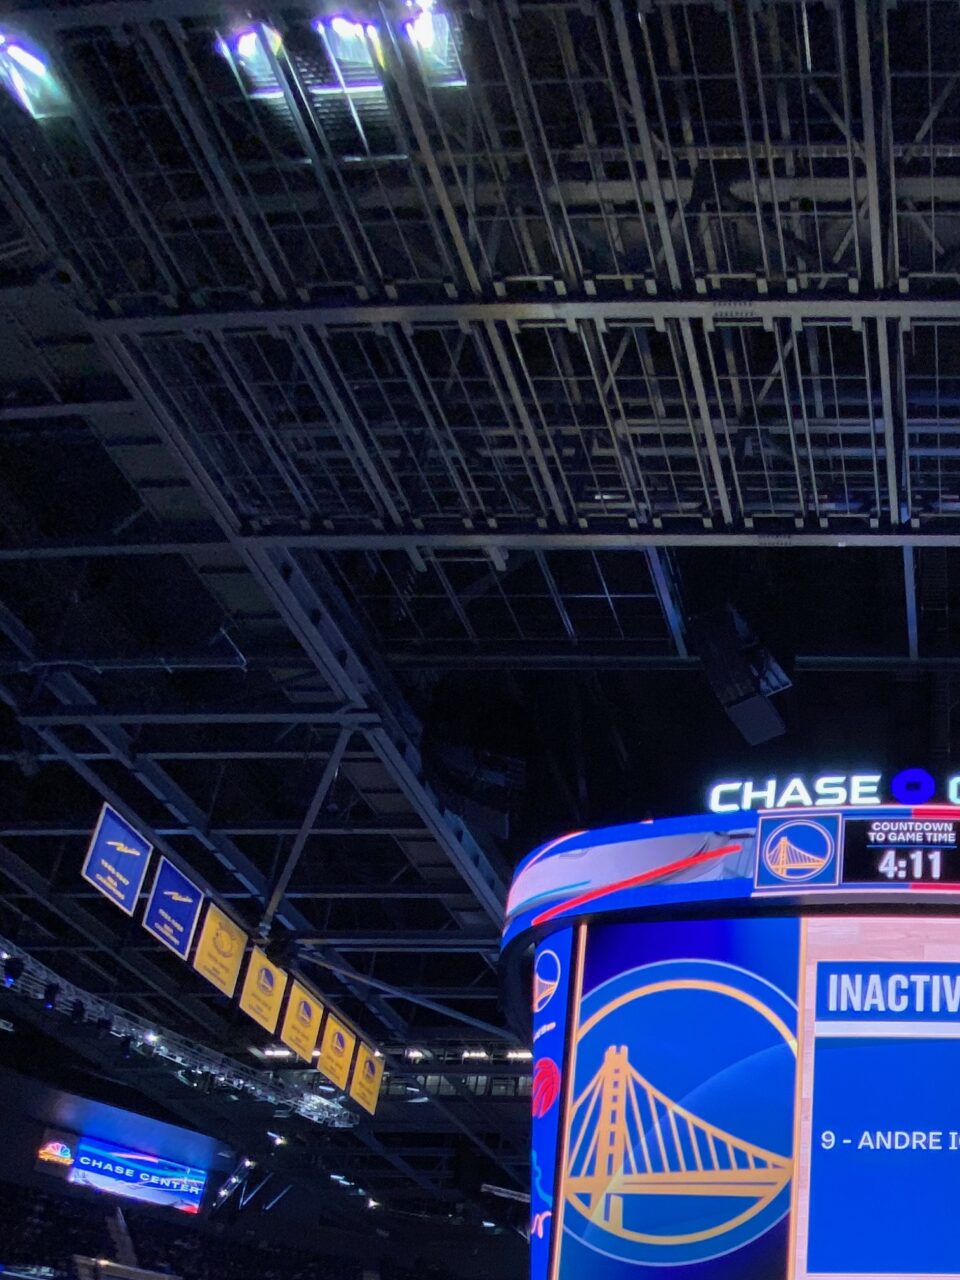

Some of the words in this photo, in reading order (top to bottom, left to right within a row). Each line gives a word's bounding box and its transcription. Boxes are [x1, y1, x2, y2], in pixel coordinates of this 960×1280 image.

[709, 775, 882, 813] CHASE
[868, 832, 886, 842] TO
[888, 832, 925, 842] GAME
[928, 832, 956, 843] TIME
[871, 821, 954, 832] COUNTDOWN
[877, 849, 942, 880] 4:11
[821, 1131, 836, 1149] 9
[858, 1131, 942, 1150] ANDRE
[80, 1156, 134, 1177] CHASE
[139, 1173, 199, 1195] CENTER
